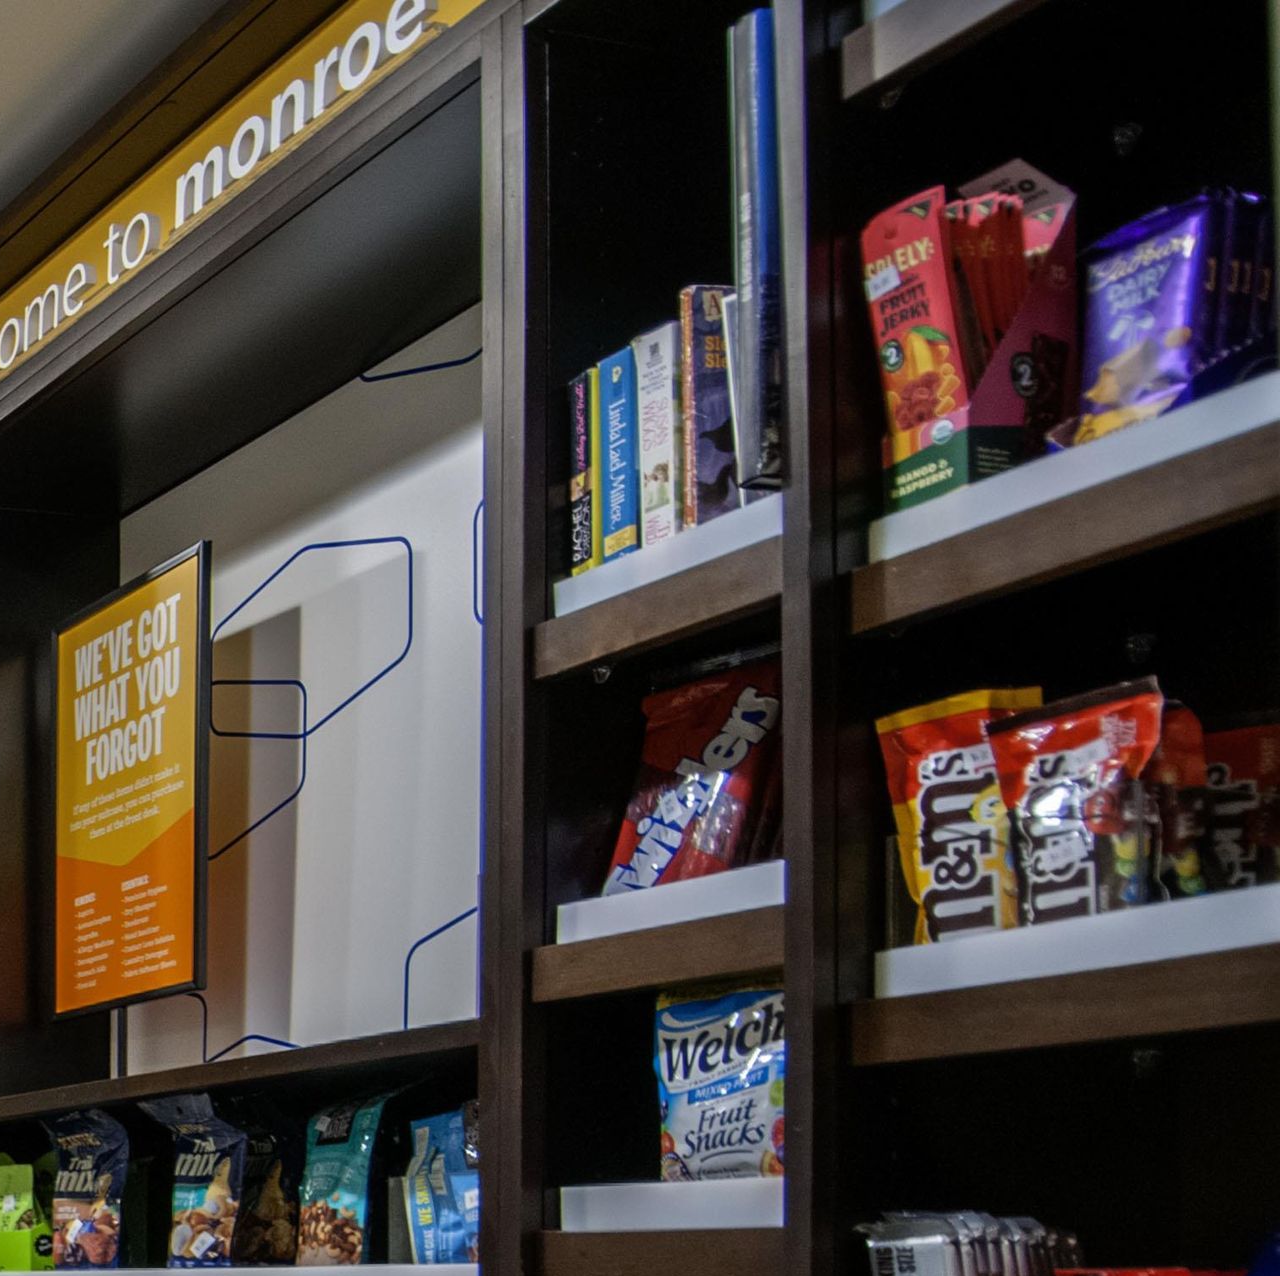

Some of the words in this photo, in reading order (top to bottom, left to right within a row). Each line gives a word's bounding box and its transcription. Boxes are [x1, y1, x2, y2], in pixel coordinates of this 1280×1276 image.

[102, 211, 155, 285] to
[173, 0, 432, 230] monroe
[880, 282, 926, 313] FRUIT
[880, 299, 930, 336] JERKY
[608, 398, 627, 443] Linda
[892, 468, 954, 498] RASPBERRY
[895, 464, 937, 485] MANGO
[608, 471, 627, 530] Miller
[572, 503, 584, 562] RACHEL
[74, 619, 134, 692] WE'VE
[137, 592, 182, 659] GOT
[74, 672, 131, 742] WHAT
[135, 646, 180, 711] YOU
[85, 706, 166, 786] FORGOT
[694, 1079, 729, 1099] MIXED
[730, 1069, 764, 1090] FRUIT
[698, 1099, 758, 1133] Fruit
[683, 1121, 766, 1160] Snacks
[69, 1155, 94, 1171] Trail
[174, 1152, 220, 1176] mix
[55, 1169, 97, 1193] mix
[896, 1245, 917, 1274] SIZE
